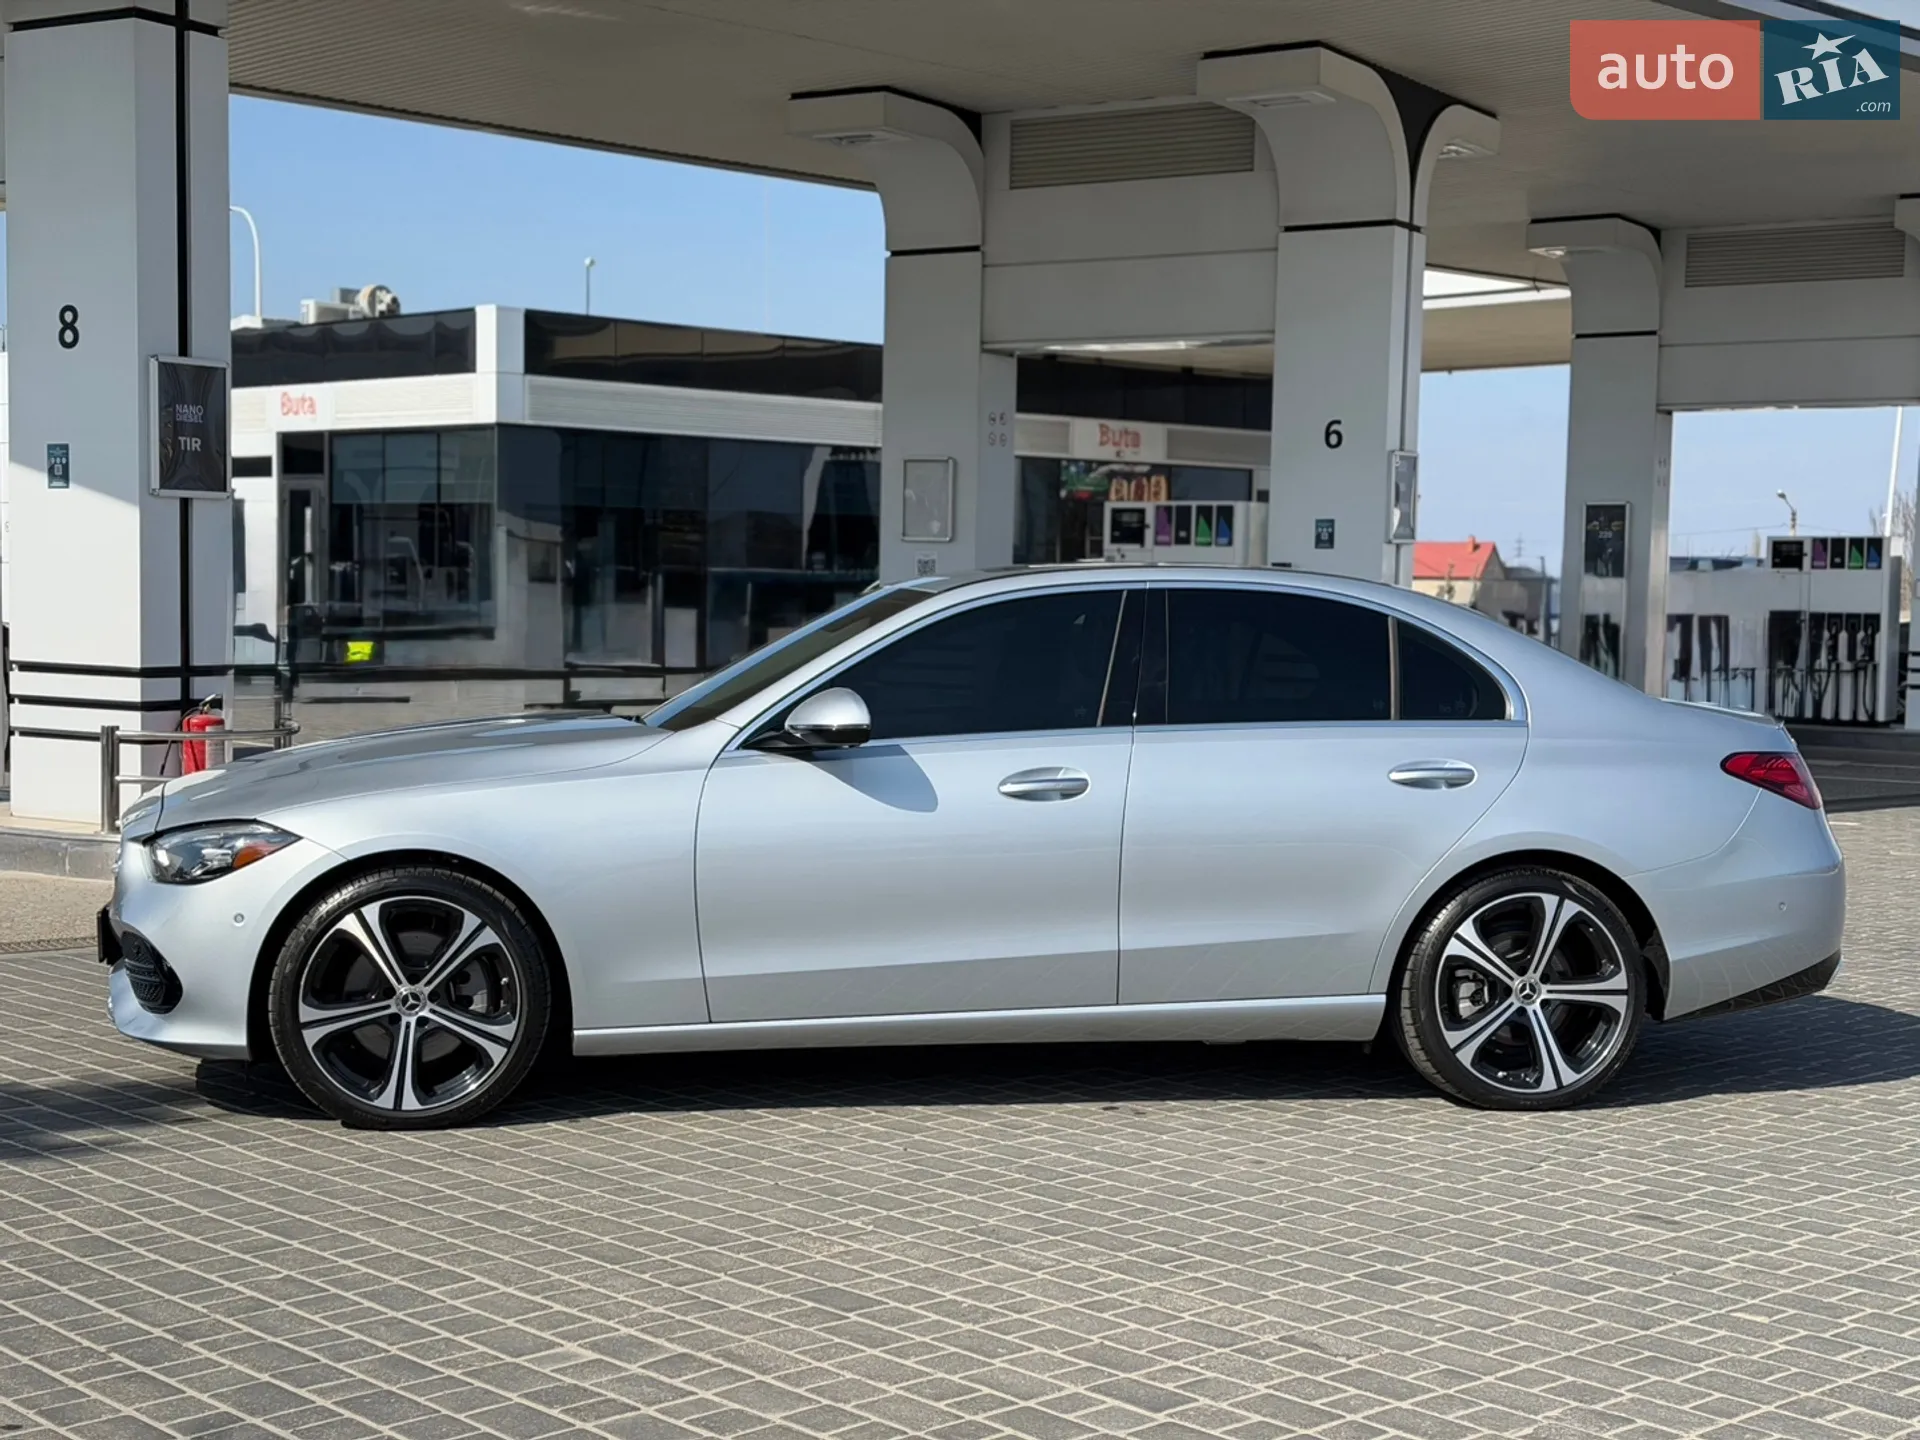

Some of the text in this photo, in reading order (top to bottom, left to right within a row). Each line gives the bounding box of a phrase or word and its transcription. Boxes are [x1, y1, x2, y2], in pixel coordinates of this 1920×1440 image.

[58, 304, 80, 349] 8
[175, 404, 204, 416] NANO
[175, 414, 203, 423] DIESEL
[178, 436, 202, 452] TIR
[1098, 422, 1141, 449] Buta
[1324, 419, 1344, 450] 6
